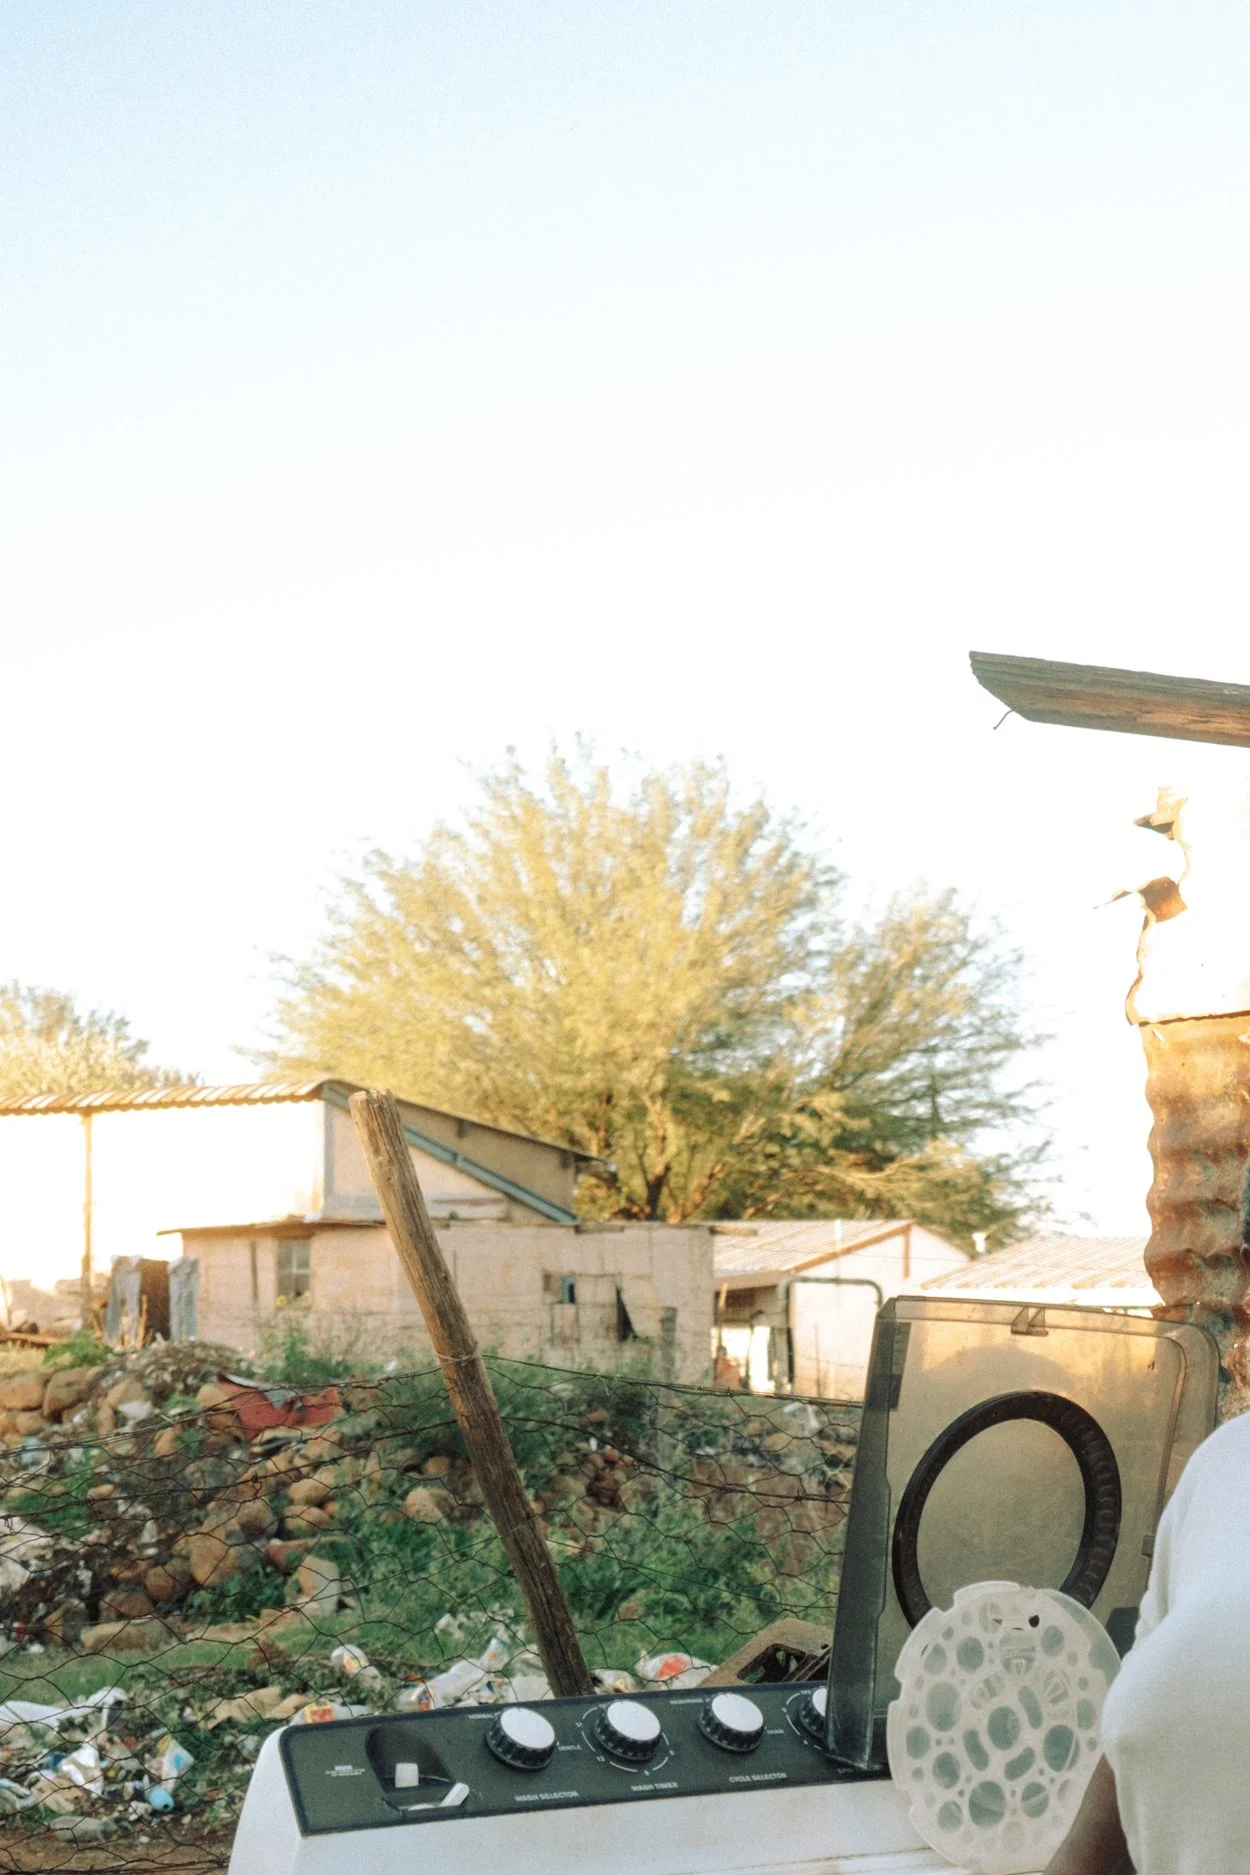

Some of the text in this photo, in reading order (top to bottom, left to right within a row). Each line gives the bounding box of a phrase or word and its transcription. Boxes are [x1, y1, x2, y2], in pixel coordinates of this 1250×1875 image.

[729, 1772, 788, 1783] CYCLE SELECTOR
[654, 1781, 679, 1789] TIMER
[539, 1790, 579, 1800] SELECTOR
